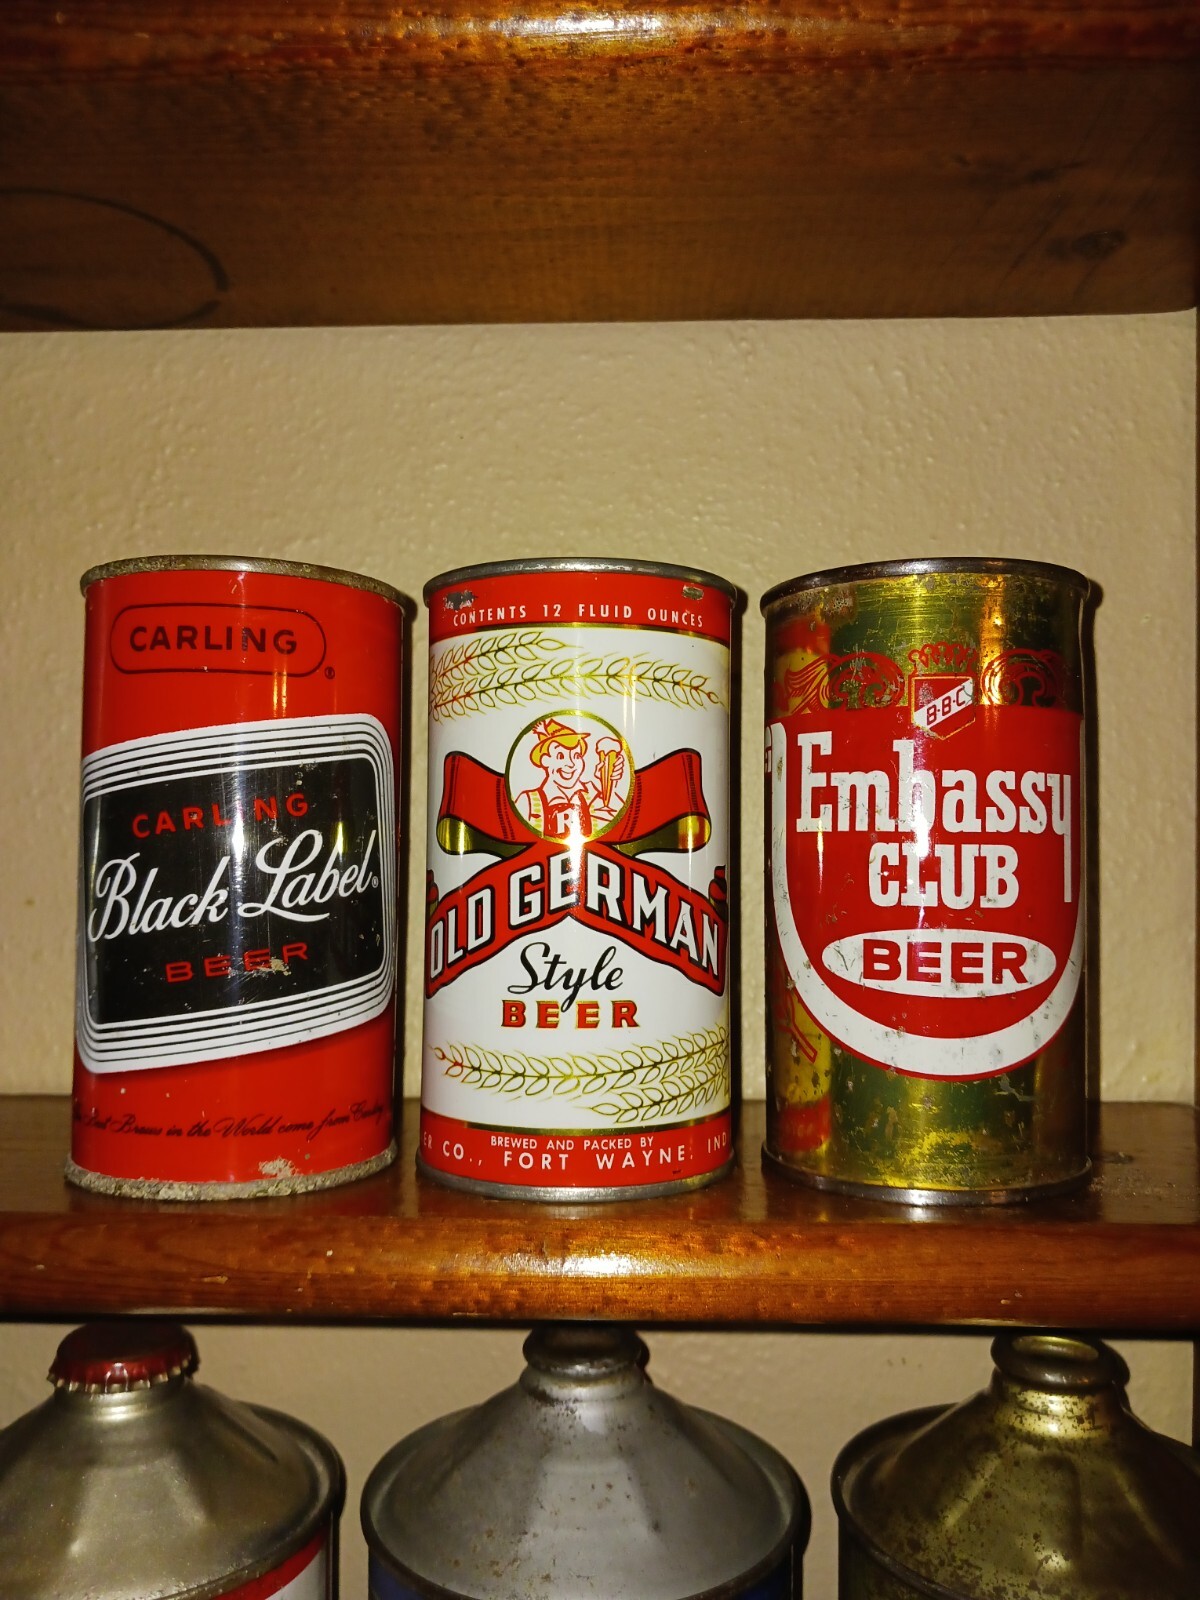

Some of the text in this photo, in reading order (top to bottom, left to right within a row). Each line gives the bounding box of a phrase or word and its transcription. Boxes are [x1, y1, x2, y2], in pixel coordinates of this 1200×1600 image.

[453, 603, 703, 628] CONTENTS 12 FLUID OUNCES
[129, 625, 298, 654] CARLING
[796, 731, 1072, 903] Embassy
[88, 829, 377, 942] Black Label
[868, 842, 1019, 910] CLUB
[429, 850, 720, 979] OLD GERMAN
[166, 942, 309, 983] BEER
[507, 941, 624, 1013] Style
[862, 938, 1029, 985] BEER
[501, 1000, 640, 1028] BEER
[187, 1119, 212, 1137] the
[213, 1113, 283, 1138] World
[307, 1108, 350, 1141] from
[490, 1135, 654, 1150] BREWED AND PACKED BY
[504, 1151, 569, 1170] FORT
